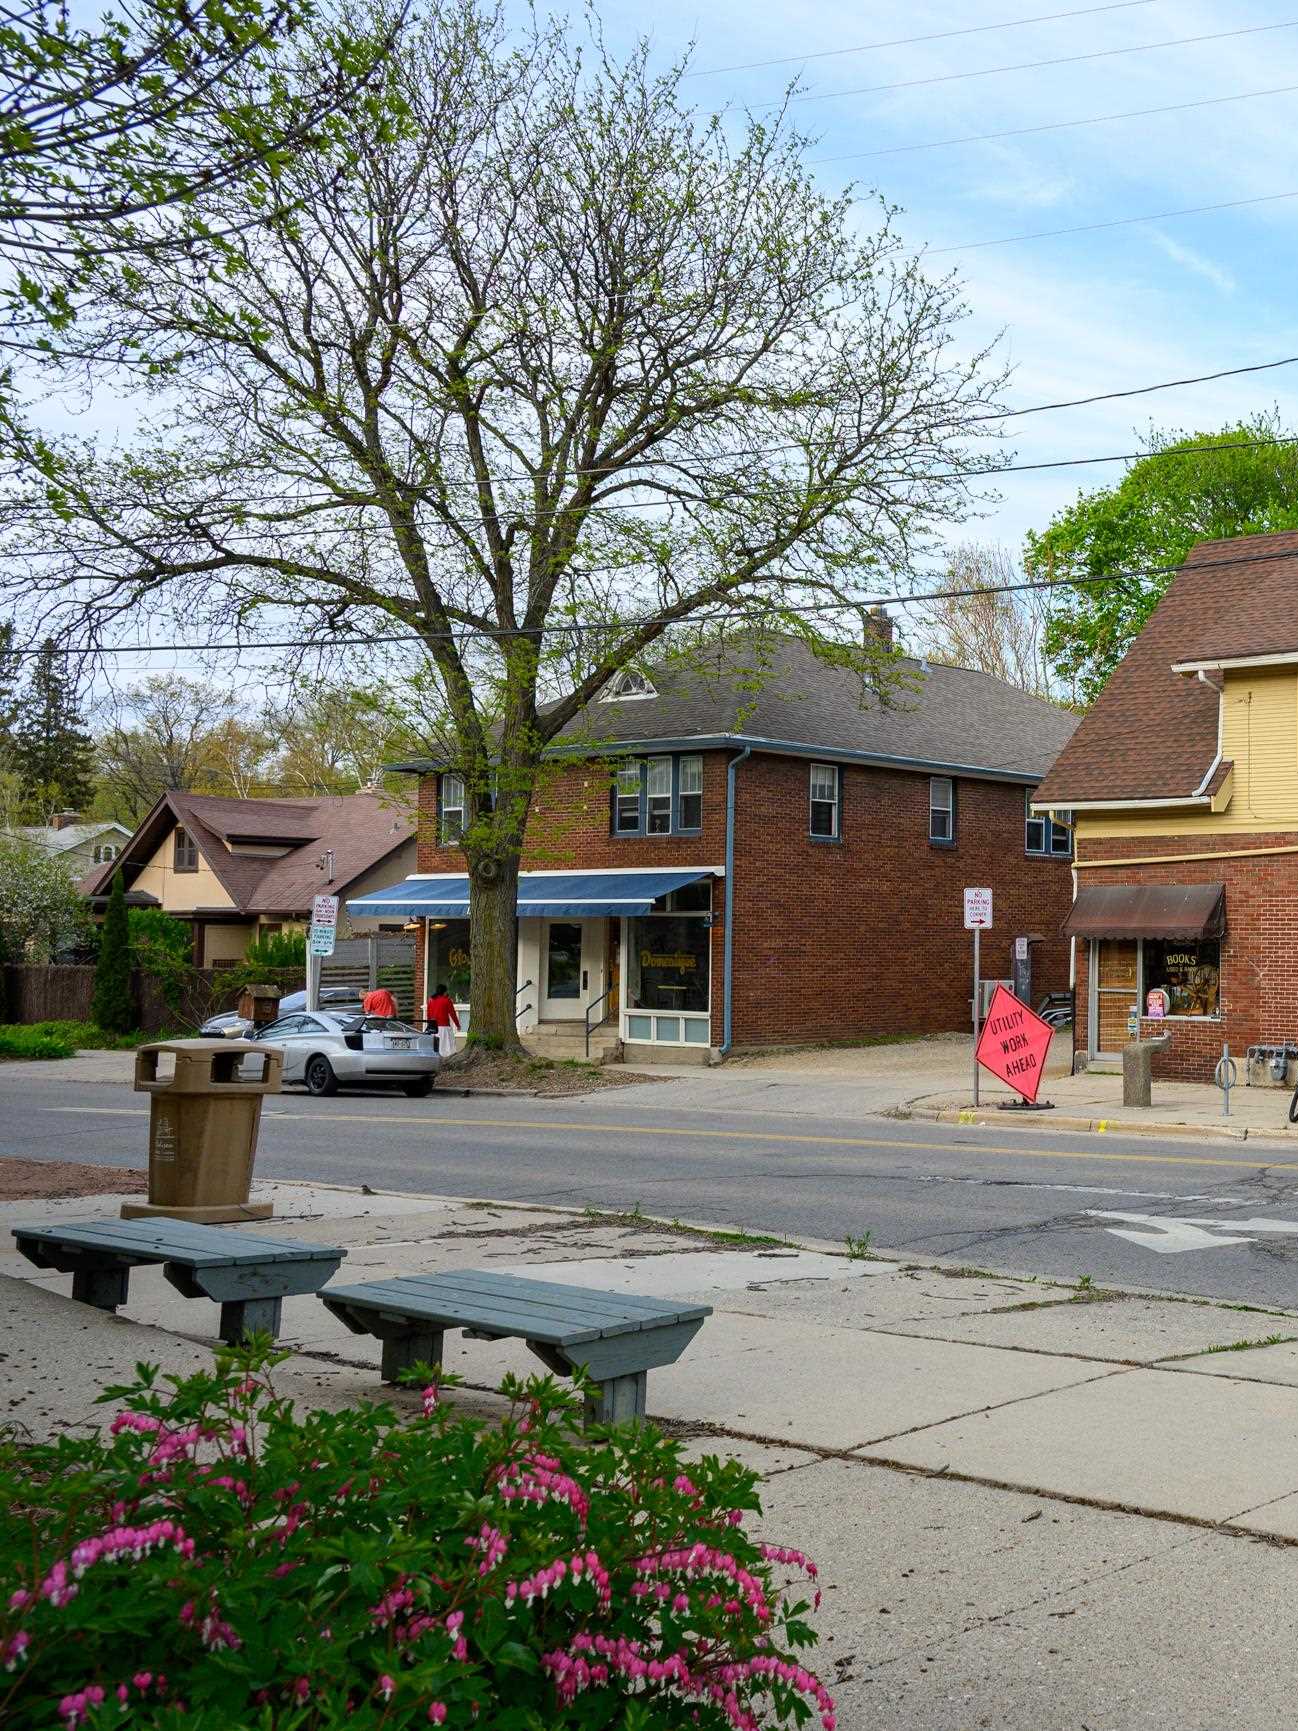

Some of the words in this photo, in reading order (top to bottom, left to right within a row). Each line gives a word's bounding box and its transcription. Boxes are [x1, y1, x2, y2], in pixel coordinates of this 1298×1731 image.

[1166, 953, 1197, 965] BOOKS
[989, 1010, 1024, 1036] UTILITY
[1000, 1032, 1029, 1055] WORK
[1006, 1053, 1037, 1078] AHEAD
